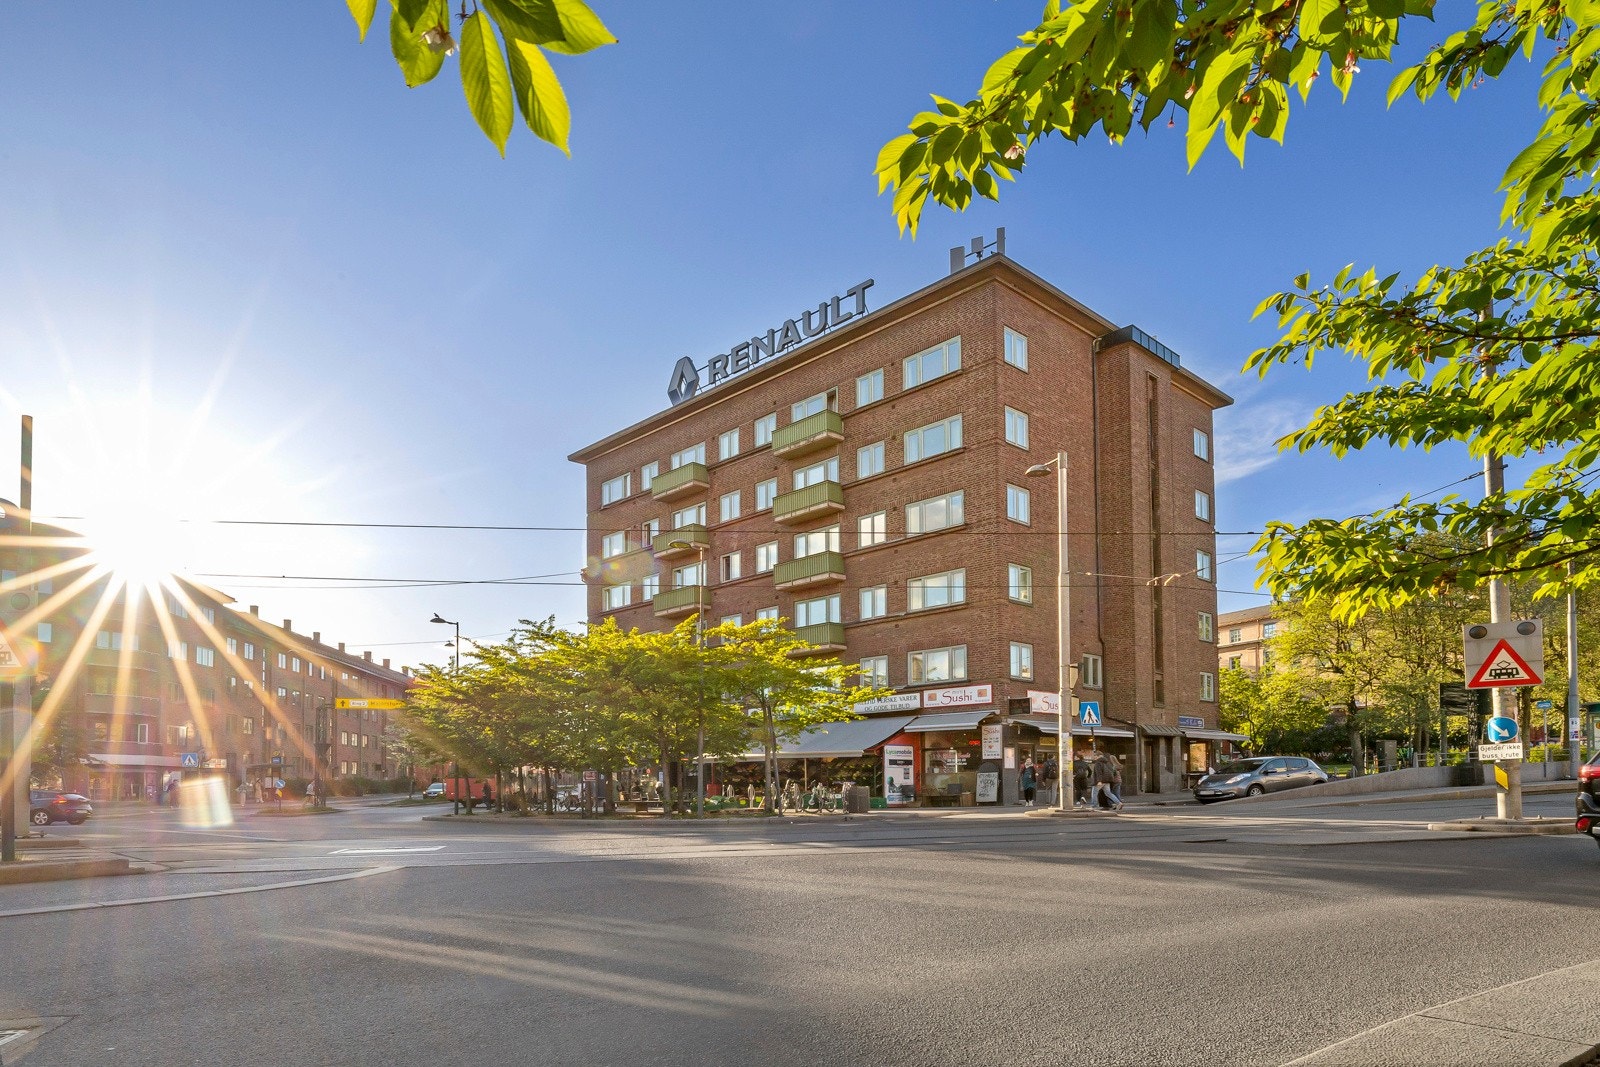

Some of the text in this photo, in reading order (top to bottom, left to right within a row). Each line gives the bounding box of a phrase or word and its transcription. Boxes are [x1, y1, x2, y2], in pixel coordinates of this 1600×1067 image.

[708, 279, 875, 384] RENAULT
[941, 689, 973, 705] Sushi
[1041, 696, 1059, 711] Sus
